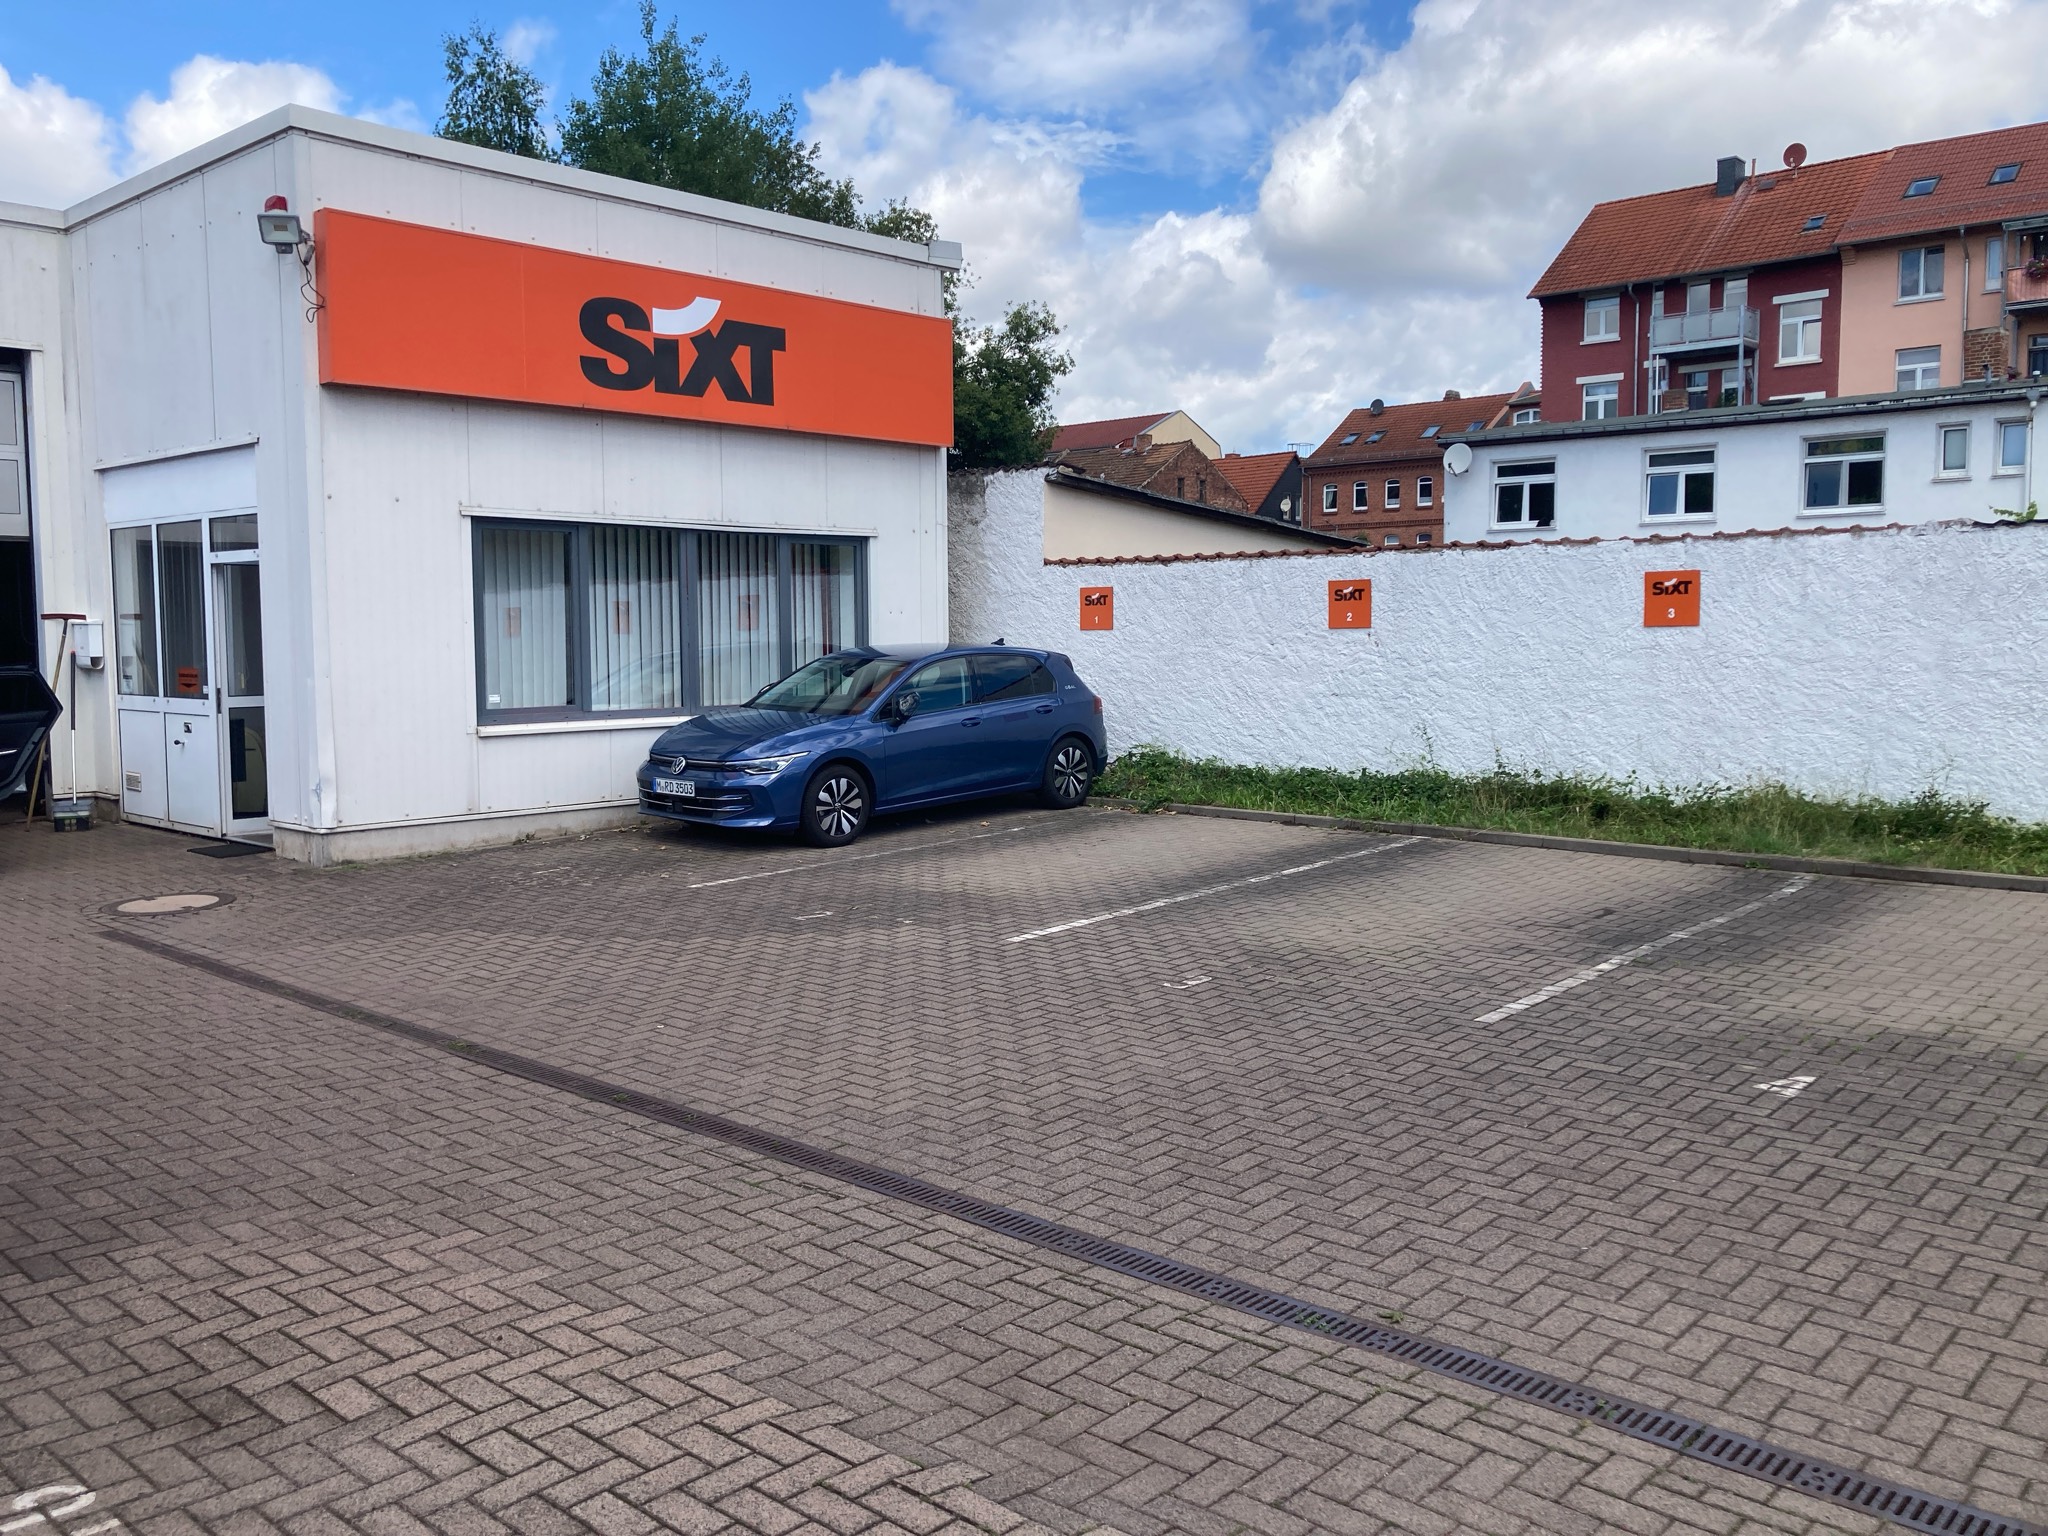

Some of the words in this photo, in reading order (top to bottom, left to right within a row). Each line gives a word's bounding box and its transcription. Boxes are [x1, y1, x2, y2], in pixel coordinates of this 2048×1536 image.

[1346, 612, 1353, 621] 2
[1667, 608, 1676, 618] 3
[1094, 615, 1099, 624] 1
[675, 782, 694, 795] 3503
